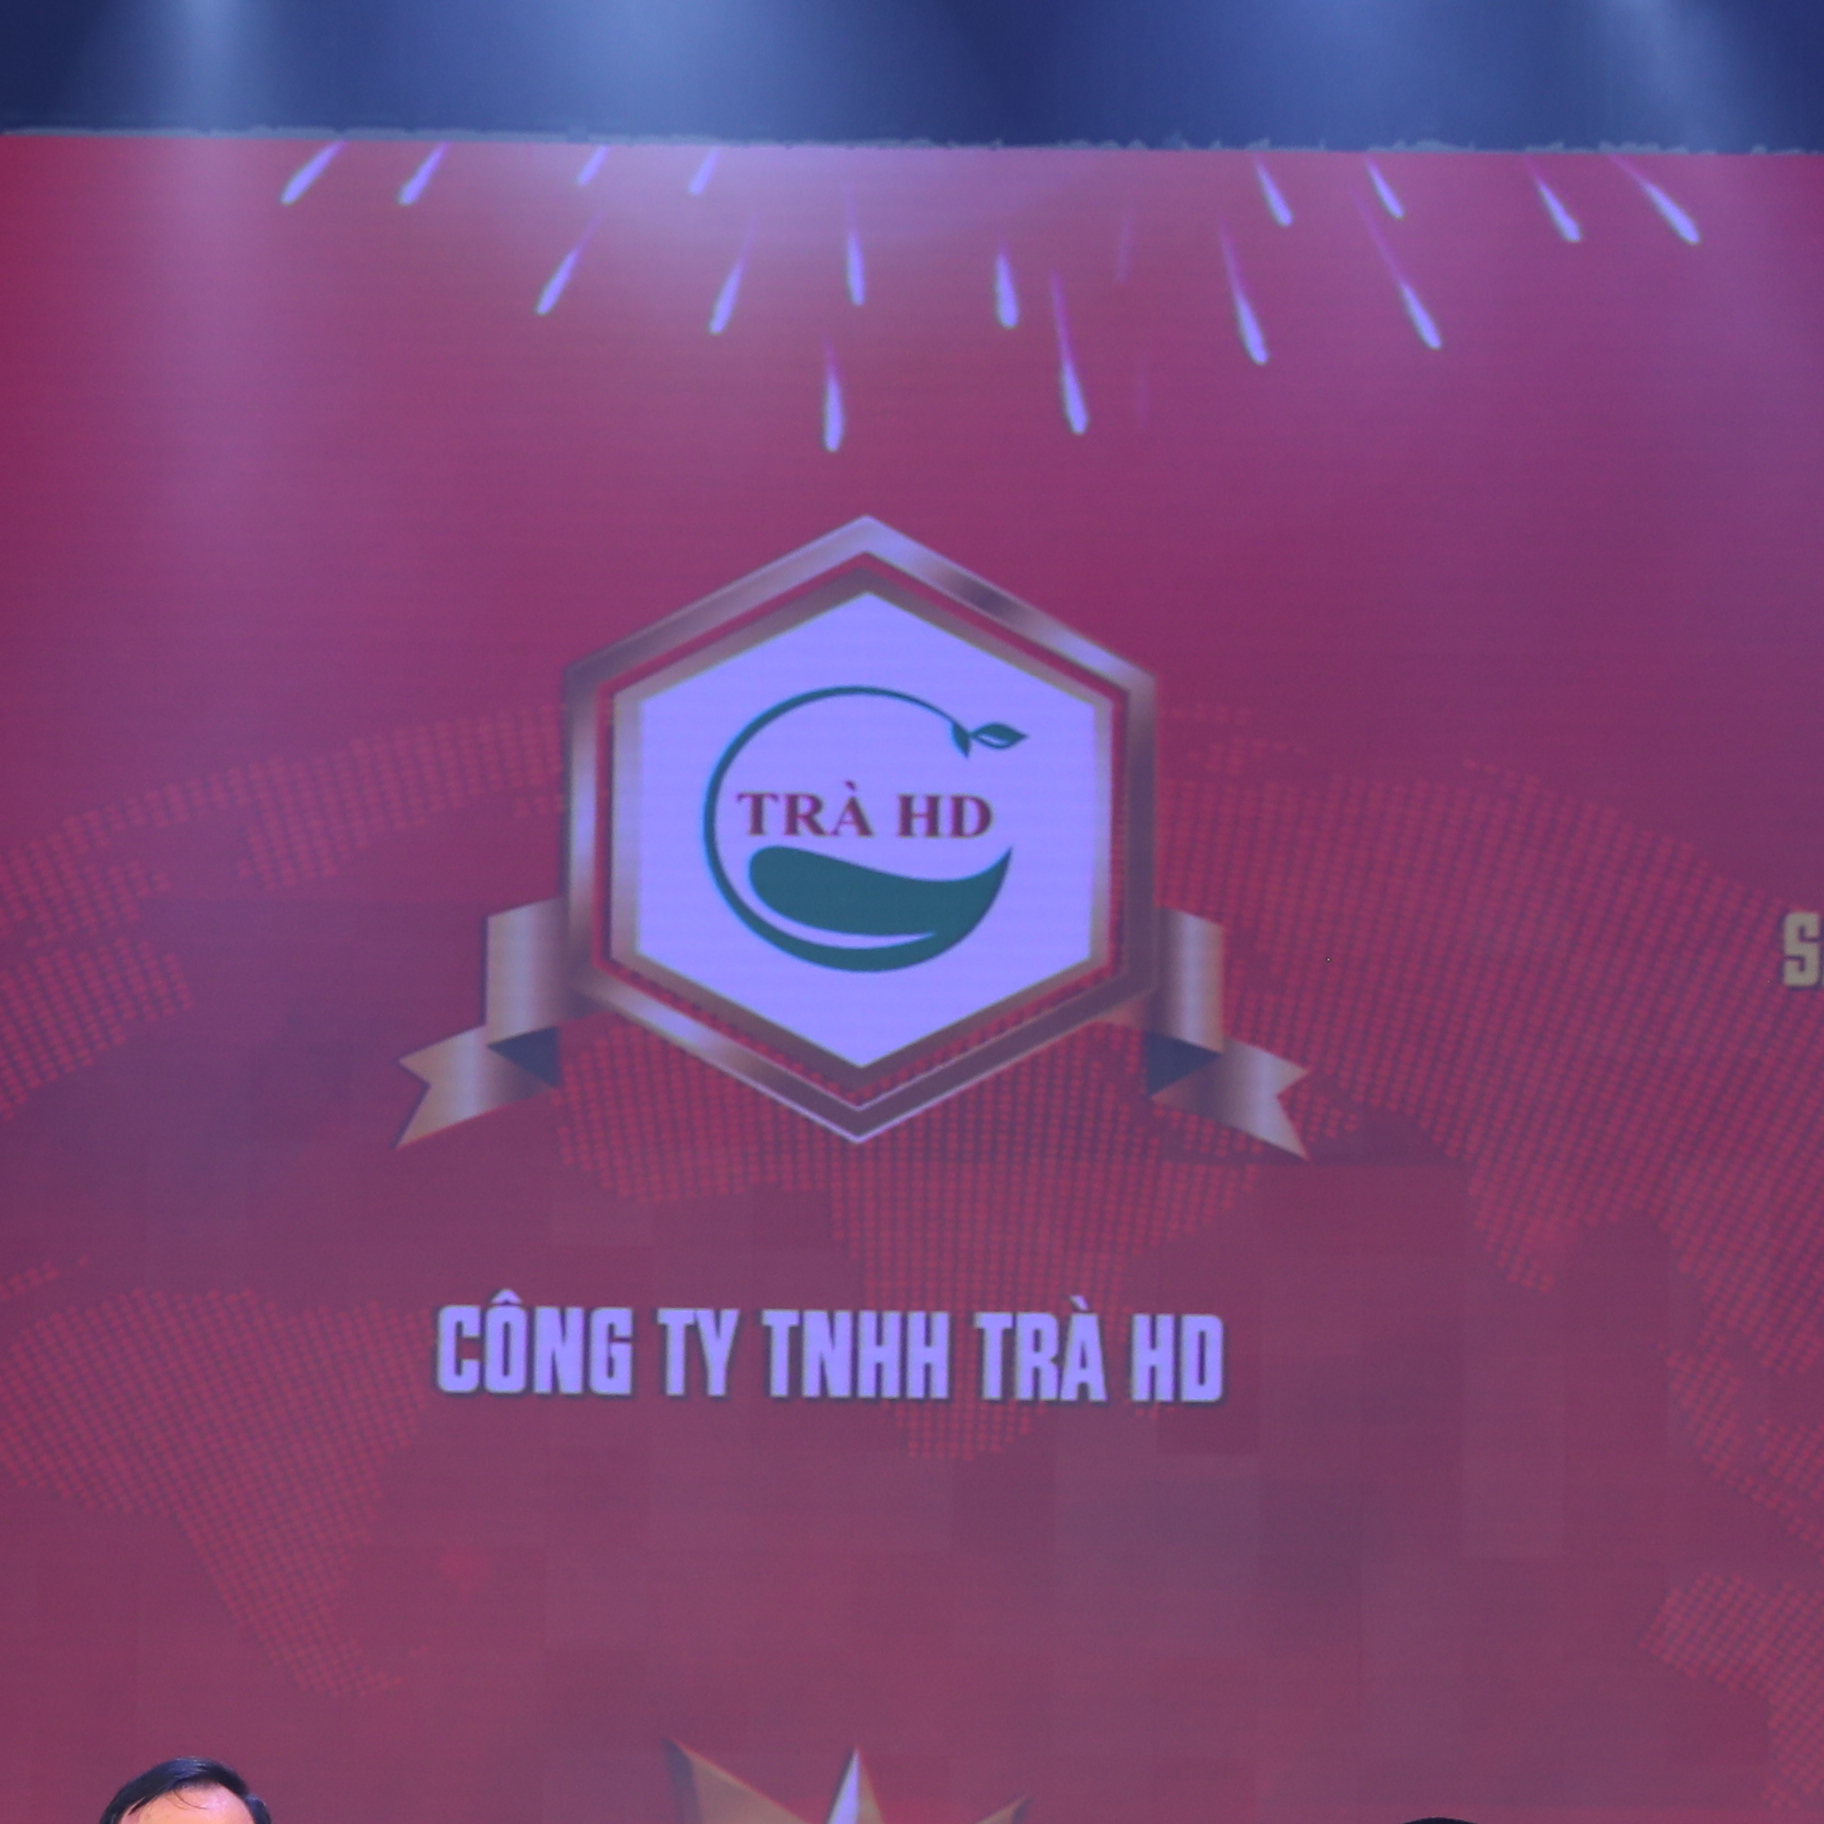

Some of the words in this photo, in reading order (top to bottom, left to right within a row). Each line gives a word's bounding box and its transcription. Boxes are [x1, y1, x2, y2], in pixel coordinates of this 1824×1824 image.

[737, 780, 873, 837] TRÀ
[897, 794, 992, 838] HD
[437, 1289, 633, 1396] CÔNG
[657, 1307, 738, 1396] TY
[762, 1310, 949, 1400] TNHH
[975, 1295, 1105, 1402] TRÀ
[1131, 1314, 1223, 1403] HD
